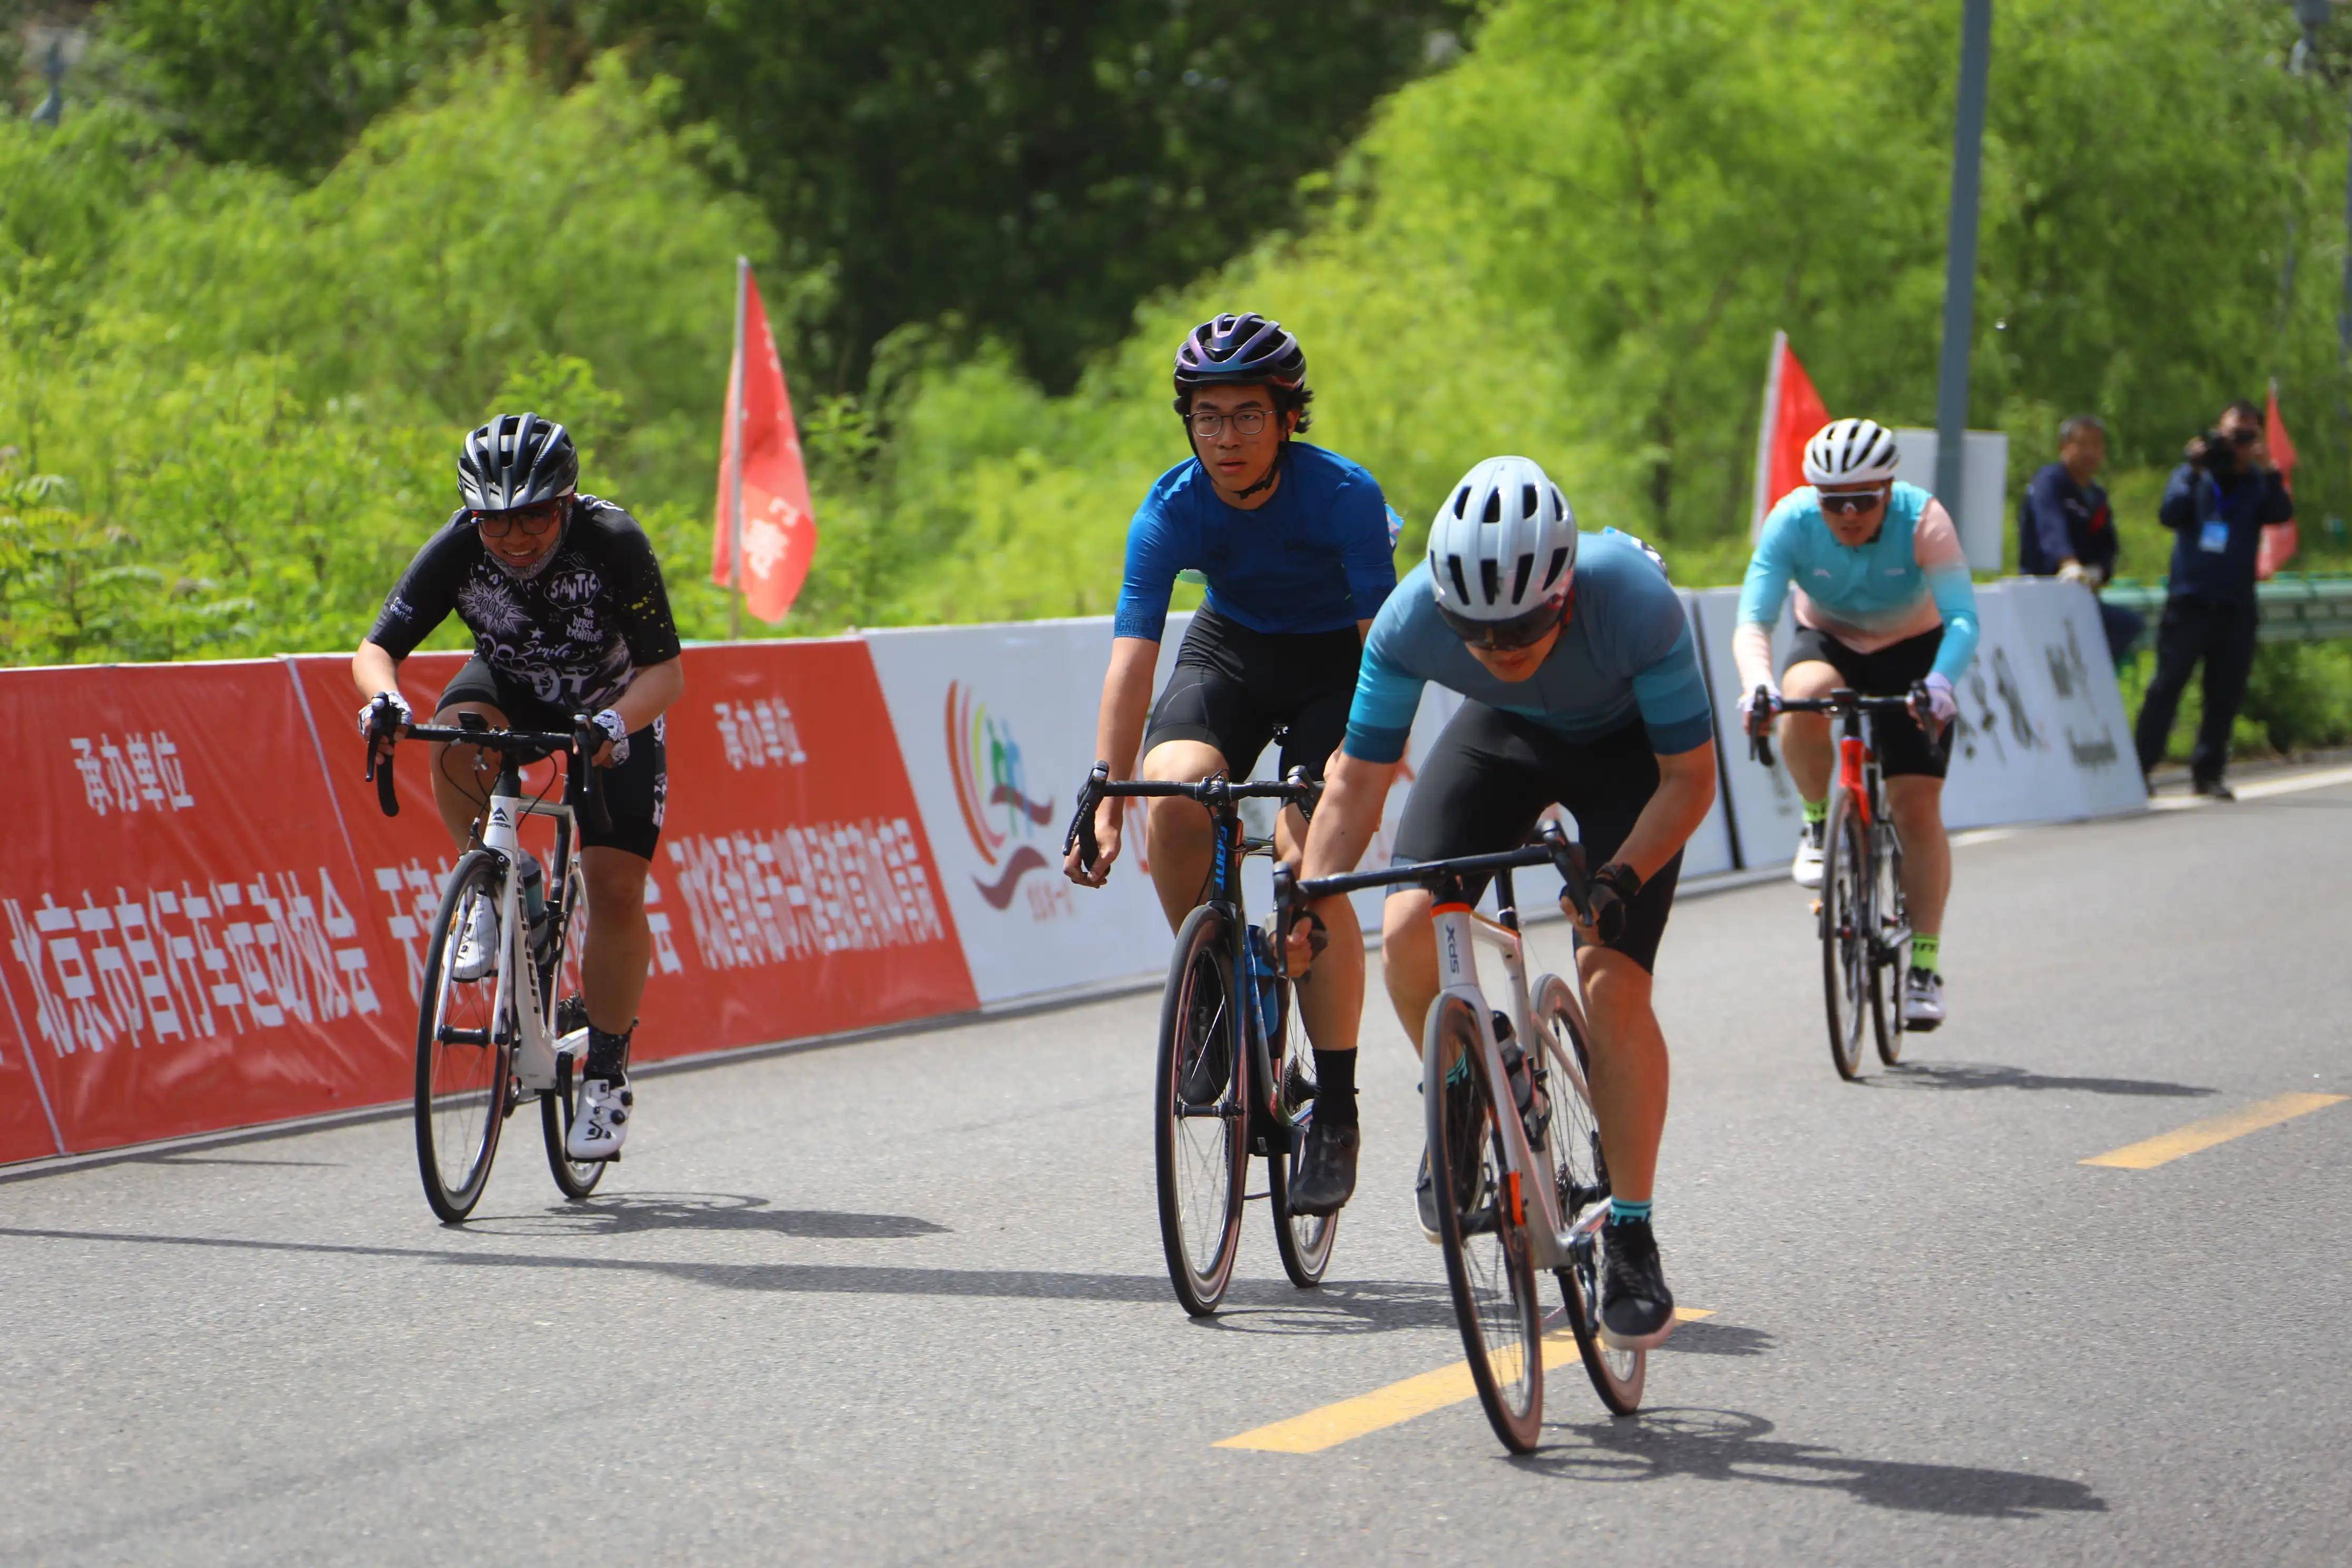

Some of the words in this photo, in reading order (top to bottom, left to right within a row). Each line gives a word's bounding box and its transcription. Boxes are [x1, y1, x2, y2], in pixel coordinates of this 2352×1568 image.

[550, 573, 597, 601] SANTIC
[519, 640, 573, 659] Smile
[71, 730, 194, 816] 承办单位
[1214, 825, 1229, 891] GIANT
[3, 866, 382, 1058] 北京市自行车运动协会
